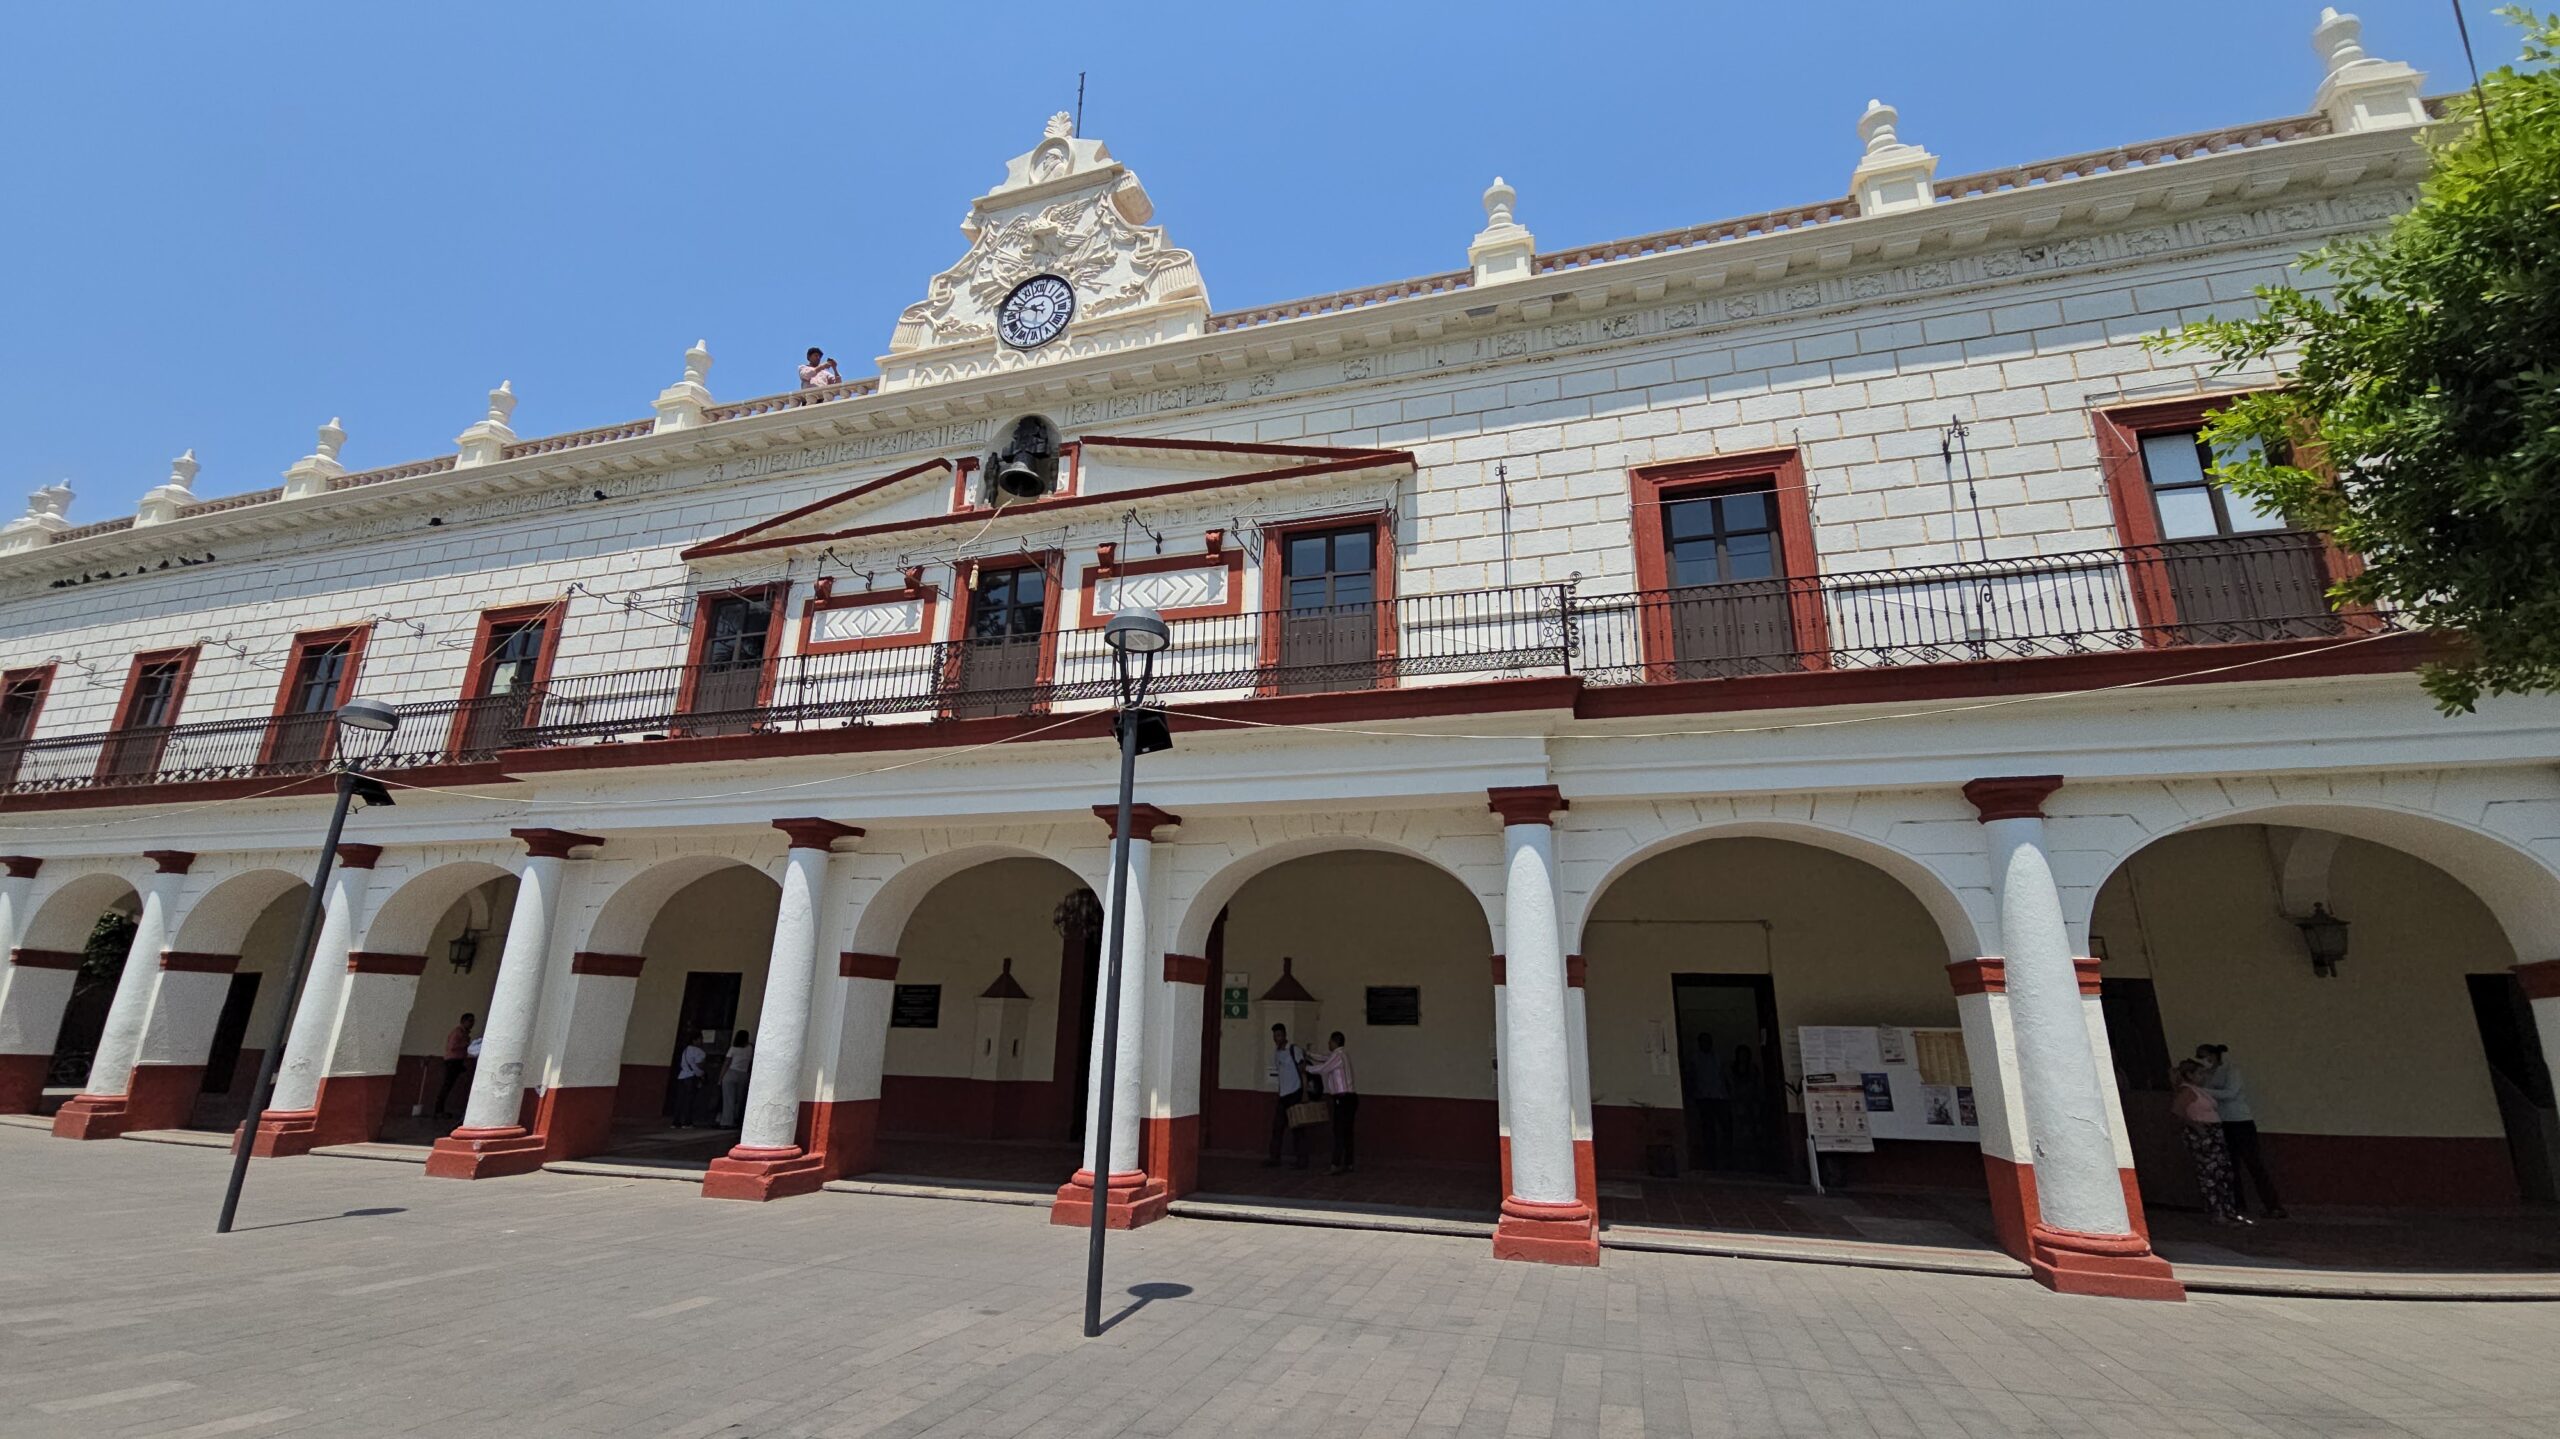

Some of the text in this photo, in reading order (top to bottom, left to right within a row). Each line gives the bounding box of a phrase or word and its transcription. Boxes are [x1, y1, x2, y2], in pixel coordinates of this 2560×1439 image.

[1034, 284, 1045, 293] XII
[1048, 285, 1055, 293] I
[1023, 289, 1031, 299] XI
[1045, 326, 1051, 334] V
